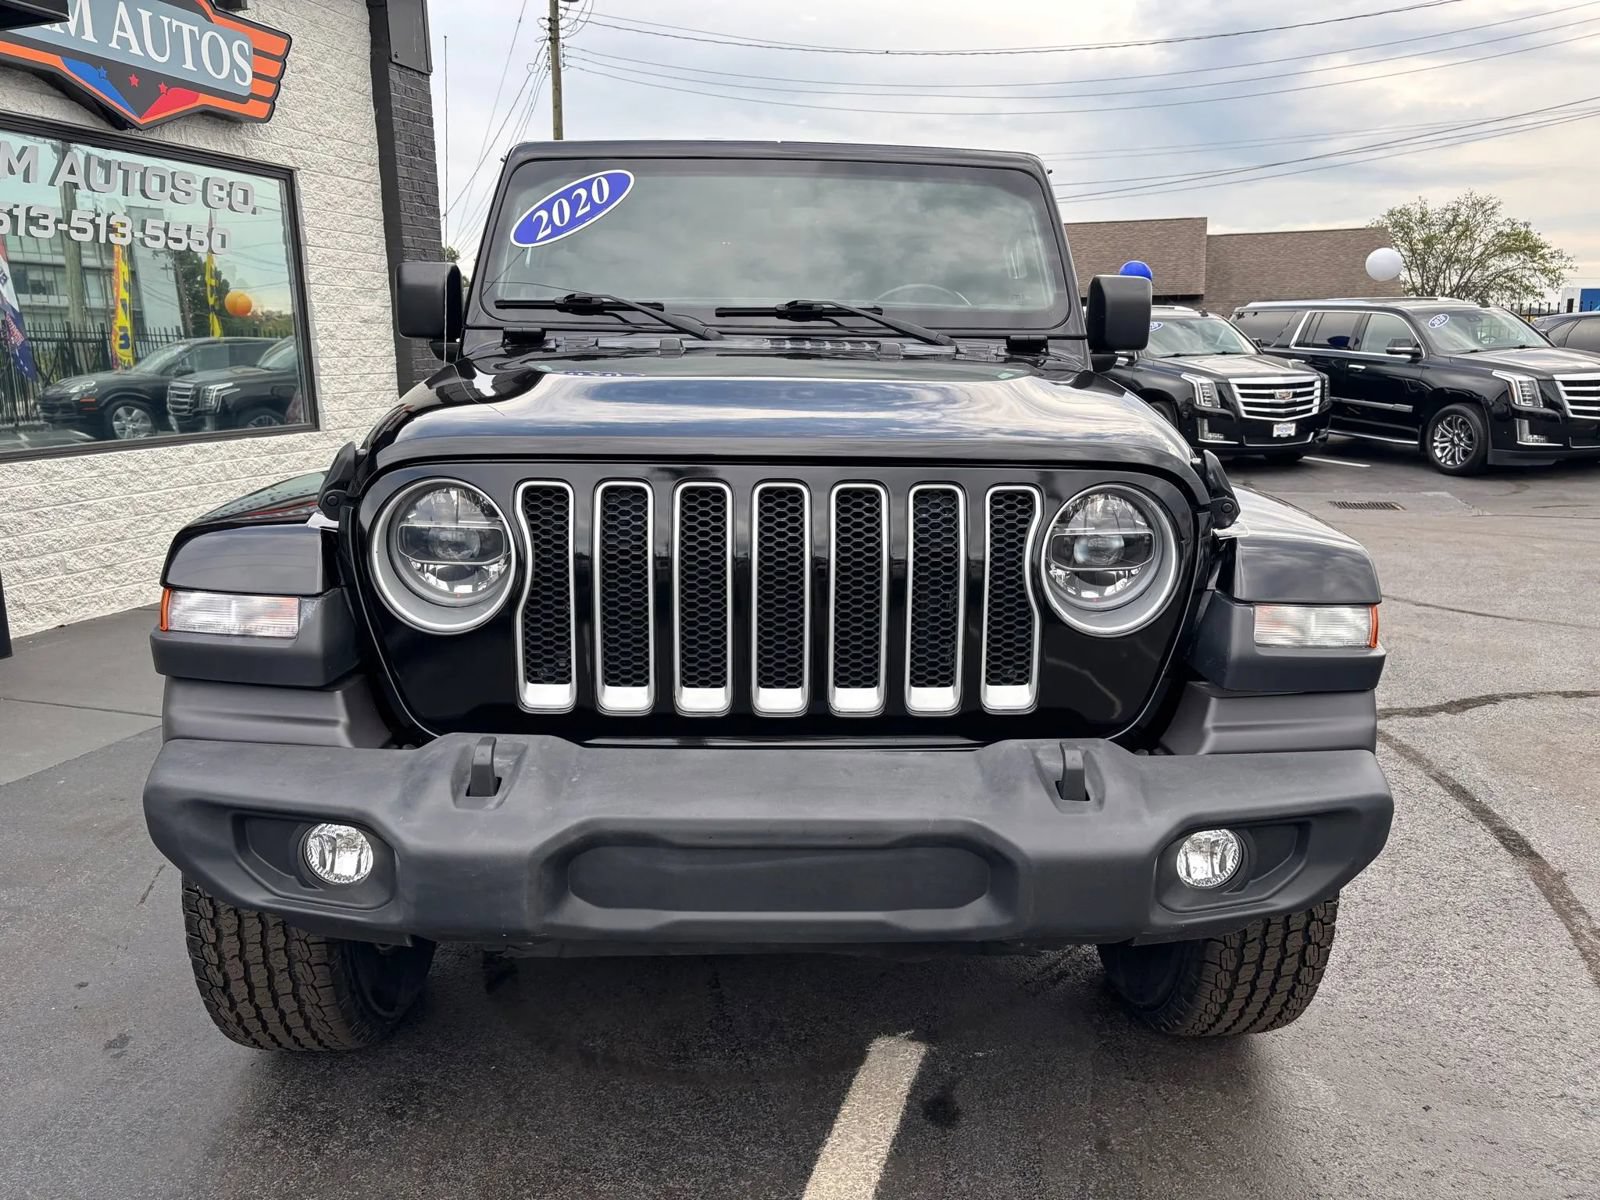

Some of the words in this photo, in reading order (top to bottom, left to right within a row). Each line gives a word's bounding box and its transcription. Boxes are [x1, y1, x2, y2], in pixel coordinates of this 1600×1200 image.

[41, 0, 98, 43] M
[108, 1, 252, 86] AUTOS
[54, 151, 197, 205] AUTOS
[532, 176, 610, 241] 2020
